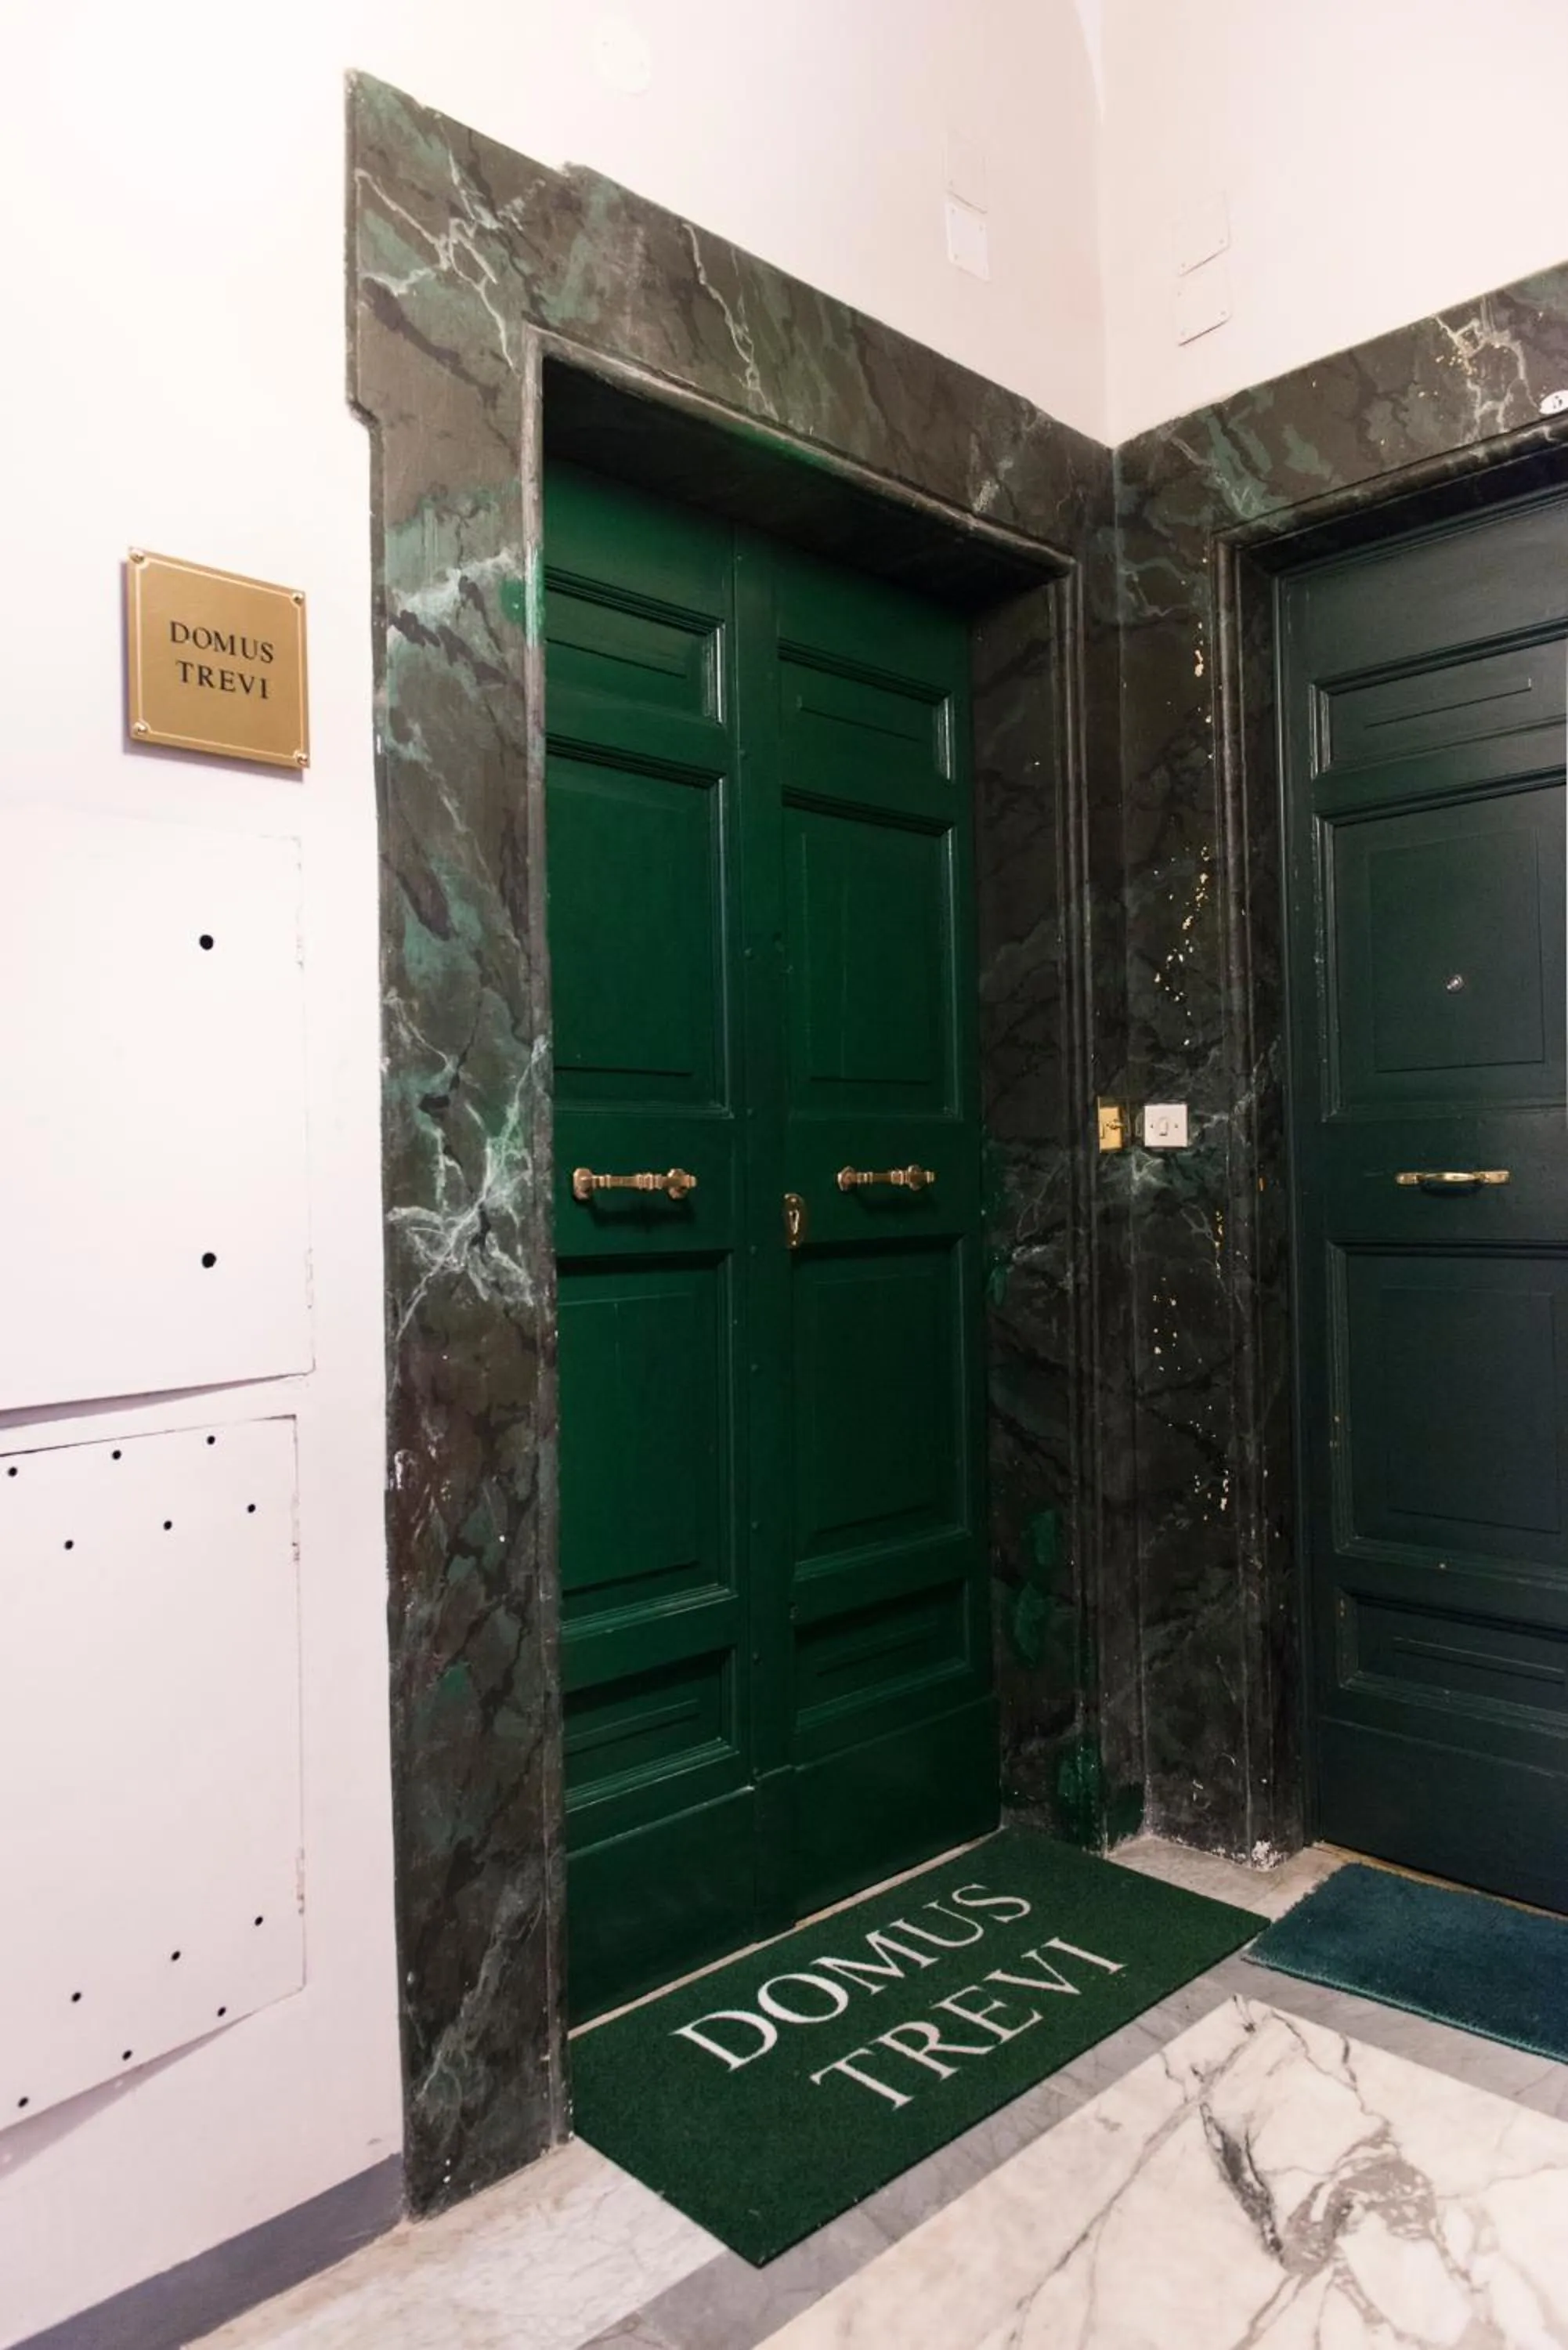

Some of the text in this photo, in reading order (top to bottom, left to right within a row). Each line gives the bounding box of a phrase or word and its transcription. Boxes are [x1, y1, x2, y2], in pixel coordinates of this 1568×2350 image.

[170, 621, 273, 663] DOMUS
[175, 660, 269, 699] TREVI
[669, 1884, 1031, 2071] DOMUS
[810, 1937, 1127, 2110] TREVI
